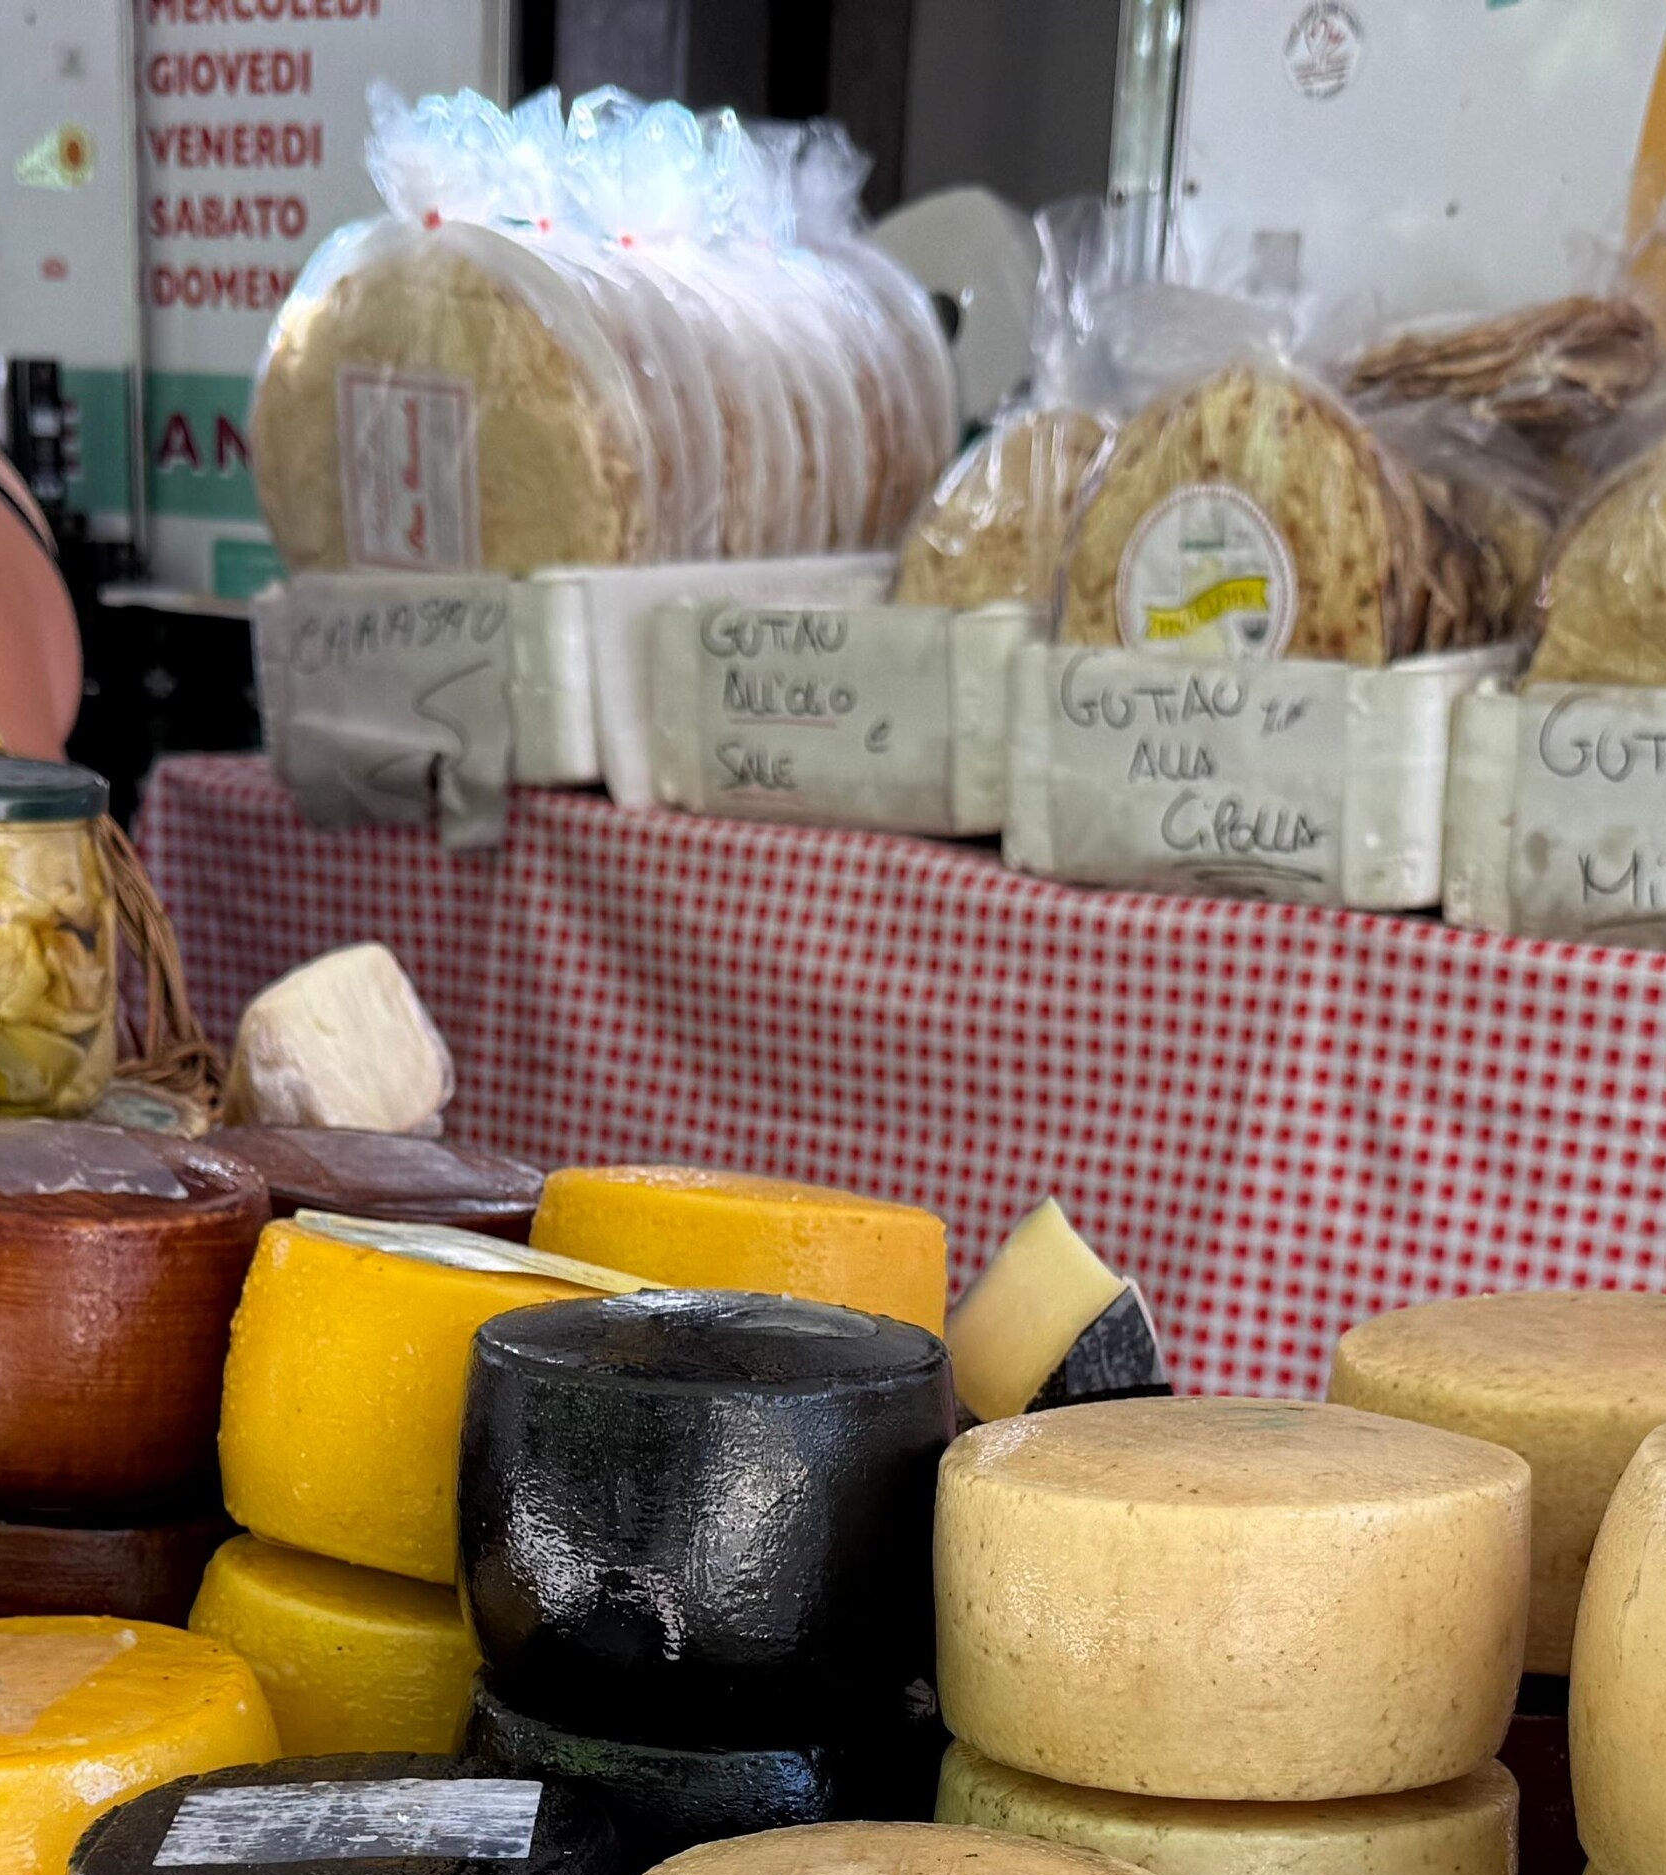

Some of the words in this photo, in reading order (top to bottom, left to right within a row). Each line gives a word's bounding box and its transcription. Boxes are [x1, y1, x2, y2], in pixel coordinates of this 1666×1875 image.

[148, 50, 313, 96] GIOVEDI
[149, 123, 322, 167] VENERDI
[150, 195, 307, 238] SABATO
[1128, 737, 1218, 783] ALLA
